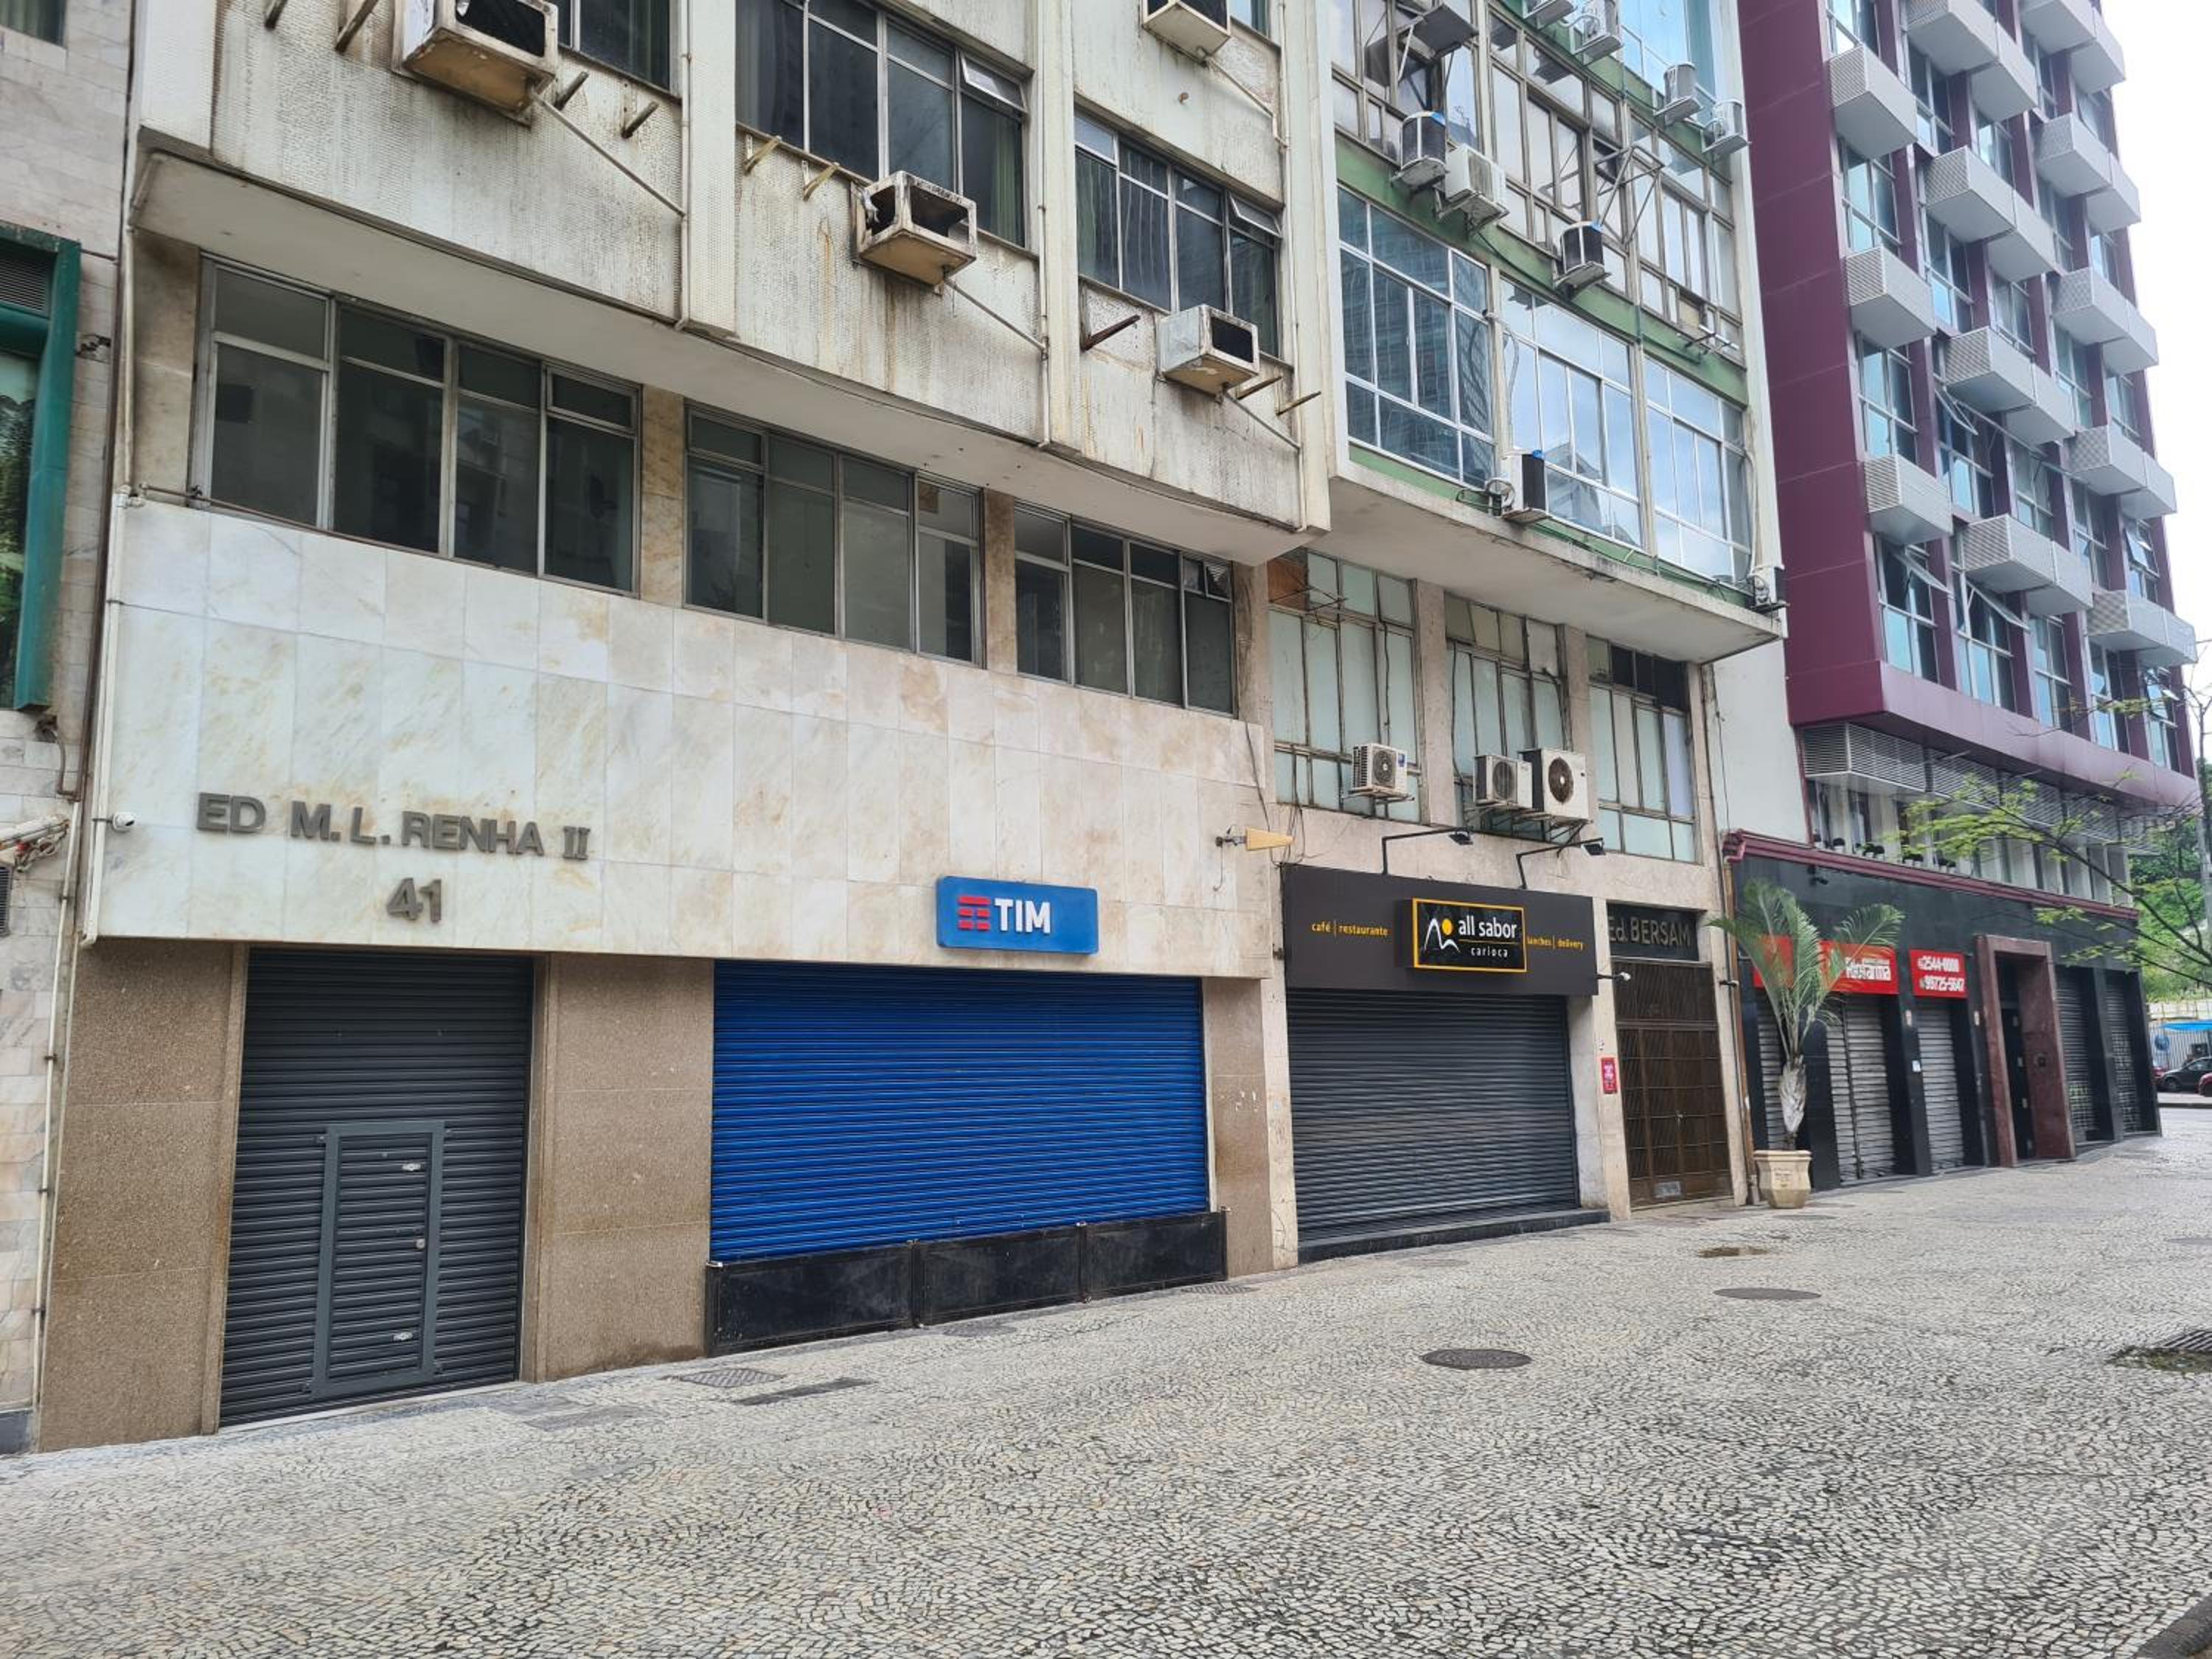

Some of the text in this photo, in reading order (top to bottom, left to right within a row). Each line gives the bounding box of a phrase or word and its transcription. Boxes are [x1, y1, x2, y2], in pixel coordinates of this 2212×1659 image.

[196, 792, 266, 834] ED
[562, 826, 590, 860] II
[386, 877, 442, 922] 41
[994, 897, 1051, 934] TIM
[1312, 921, 1388, 936] café restaurante
[1458, 915, 1517, 939] all sabor
[1630, 917, 1691, 947] BERSAM
[1471, 947, 1508, 958] carioca
